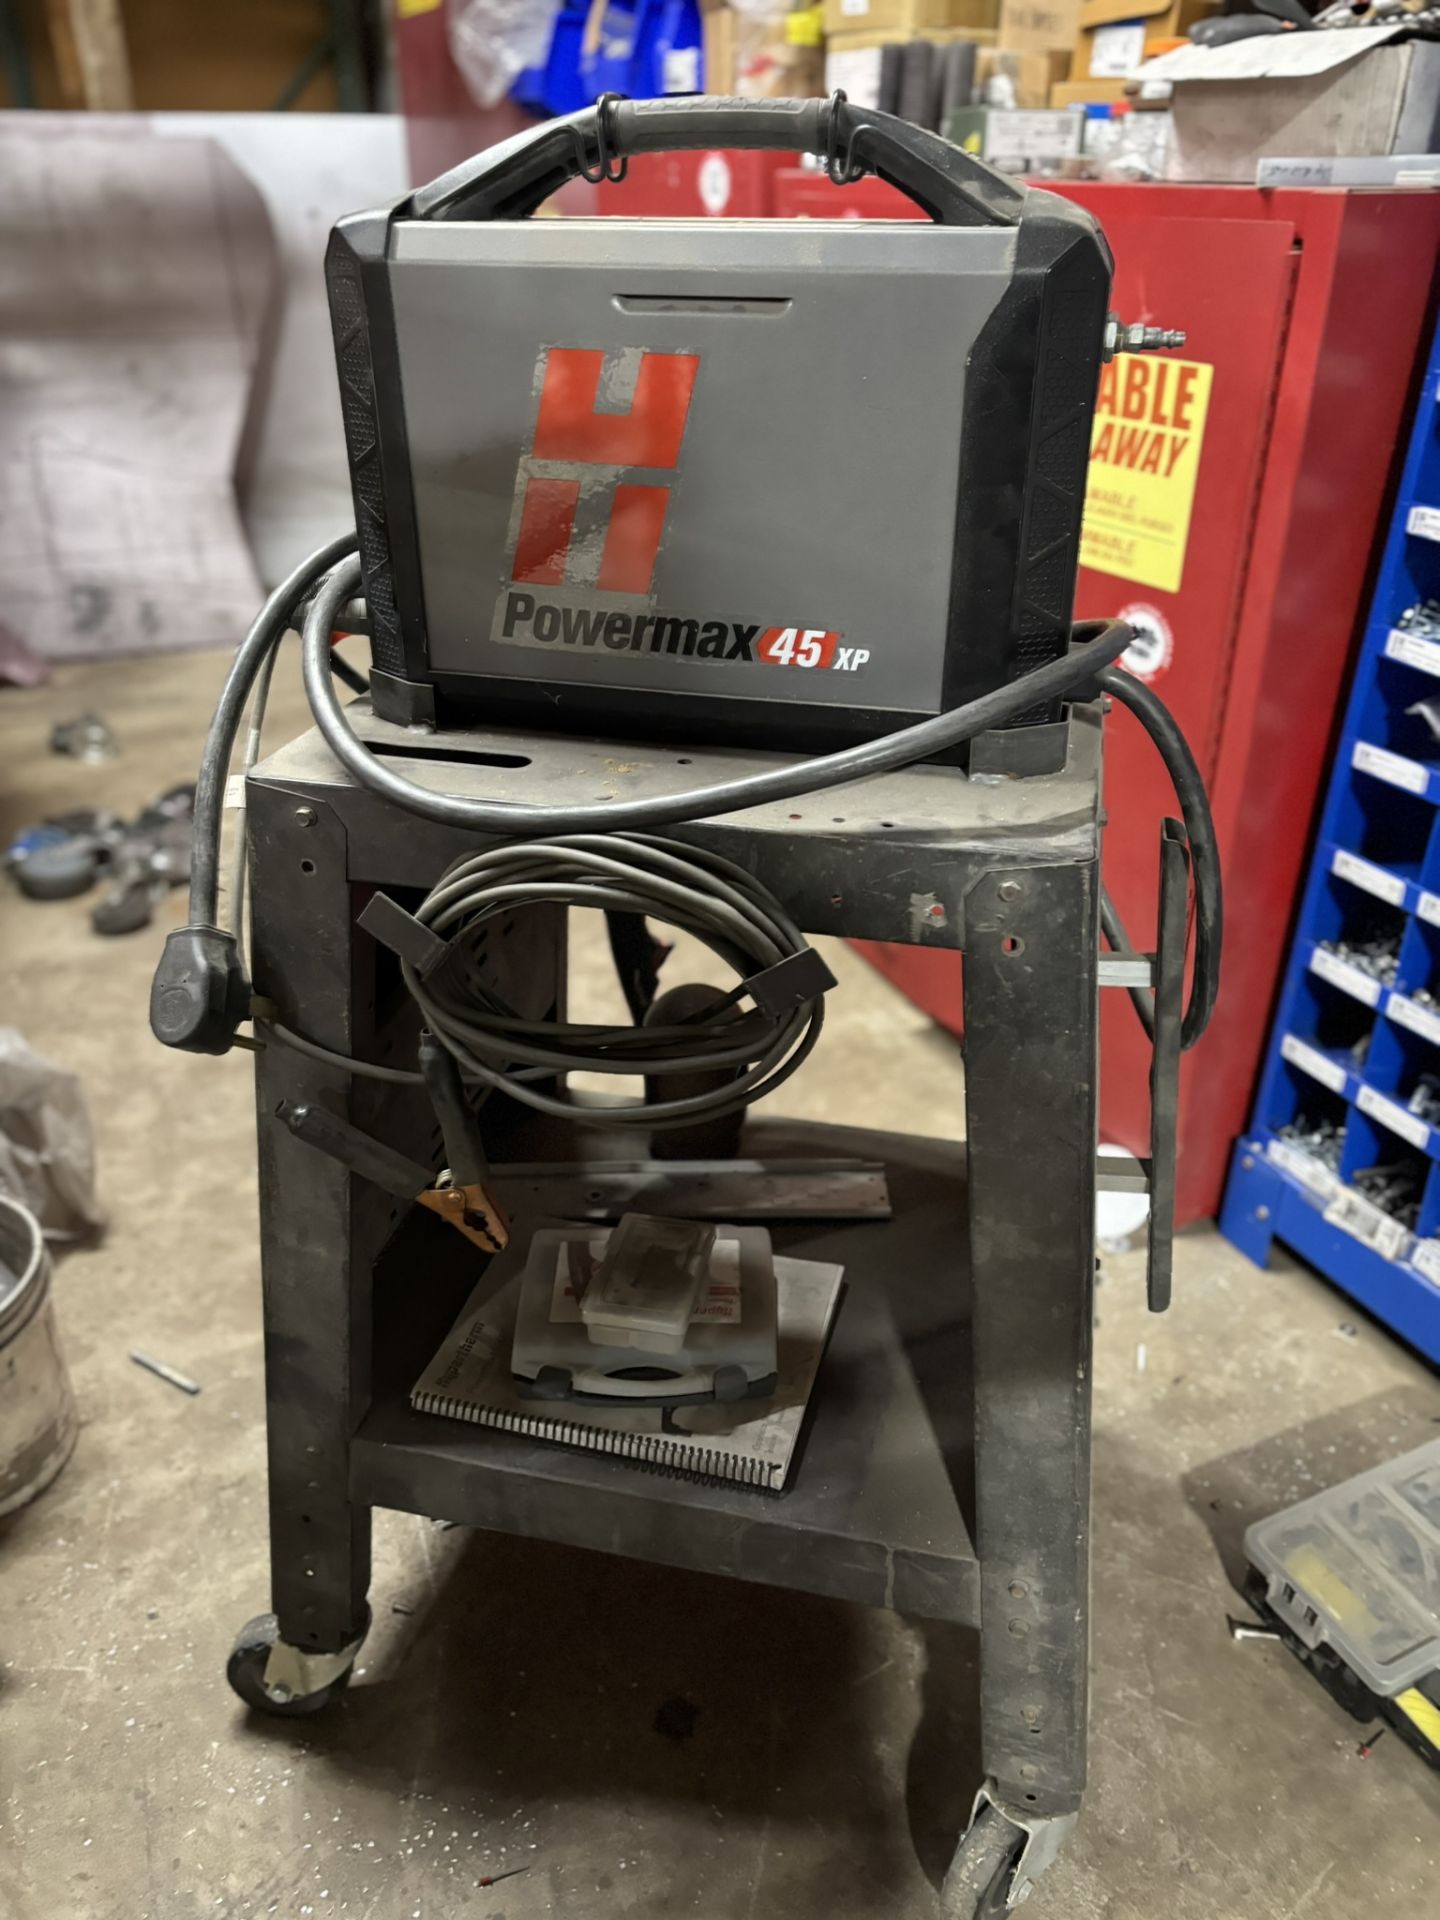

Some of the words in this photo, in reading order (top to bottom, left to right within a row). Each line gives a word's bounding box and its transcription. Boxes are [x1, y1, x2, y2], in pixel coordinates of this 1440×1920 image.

[1091, 423, 1189, 477] AWAY
[502, 592, 760, 662] Powermax
[768, 628, 826, 668] 45
[834, 647, 871, 671] XP
